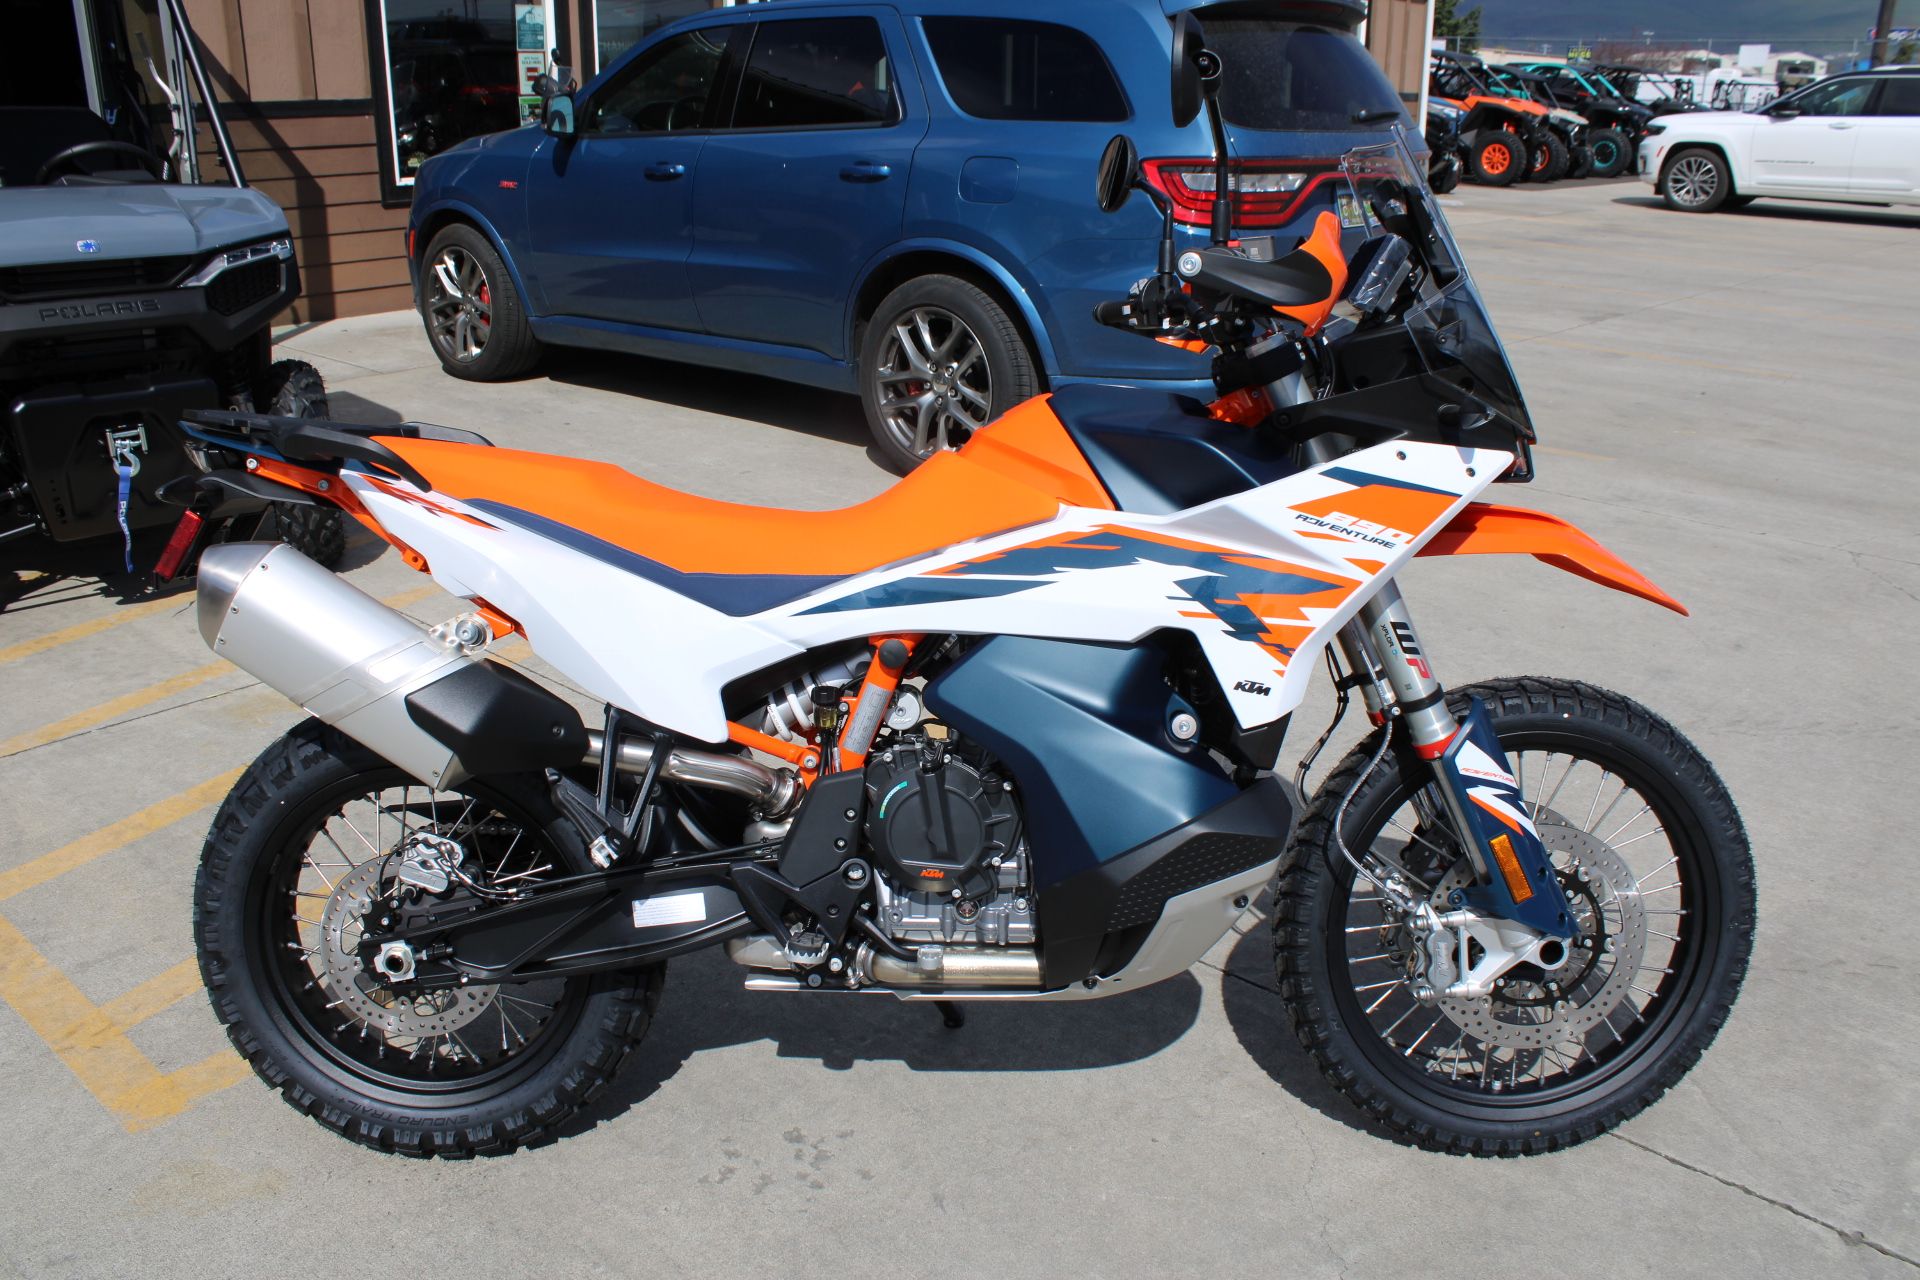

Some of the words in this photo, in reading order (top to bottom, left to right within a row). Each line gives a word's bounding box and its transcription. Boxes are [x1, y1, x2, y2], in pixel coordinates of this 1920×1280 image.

[39, 299, 160, 322] POLARIS
[1295, 513, 1397, 550] ADVENTURE
[1390, 621, 1431, 679] WP
[1233, 679, 1272, 697] KTM
[920, 868, 945, 879] KTM
